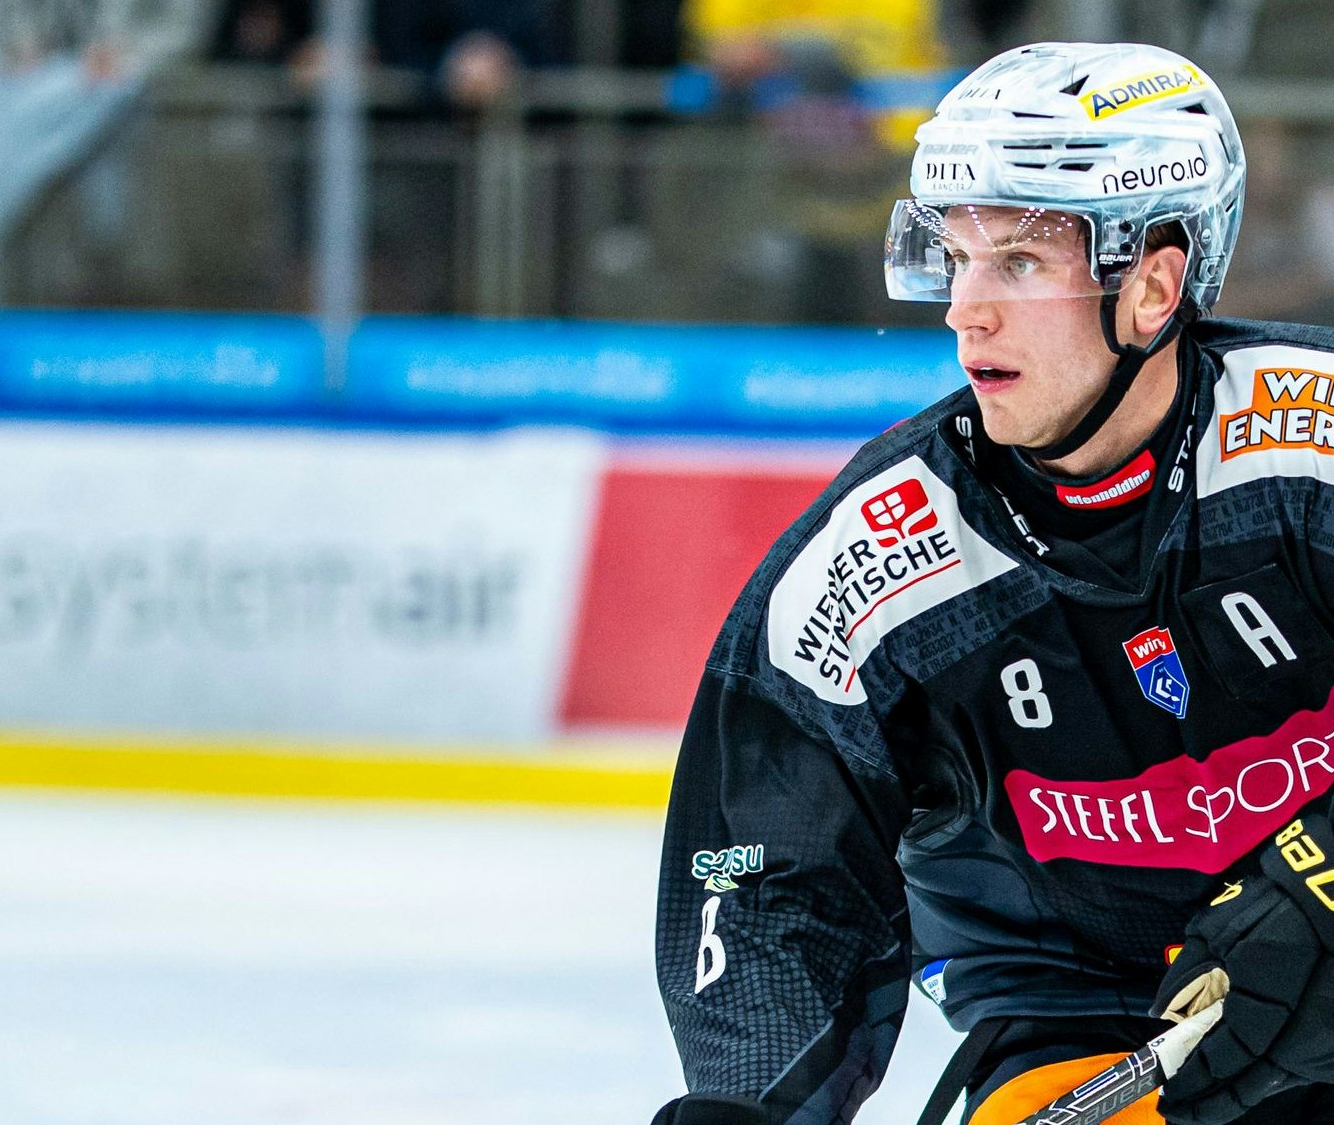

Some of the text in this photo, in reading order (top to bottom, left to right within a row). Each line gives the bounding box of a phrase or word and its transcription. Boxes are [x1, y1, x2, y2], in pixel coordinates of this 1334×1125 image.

[926, 163, 976, 181] DITA
[1099, 253, 1133, 262] BAUER
[1221, 592, 1298, 668] A
[1001, 658, 1053, 729] 8
[1029, 787, 1175, 844] STEFFL
